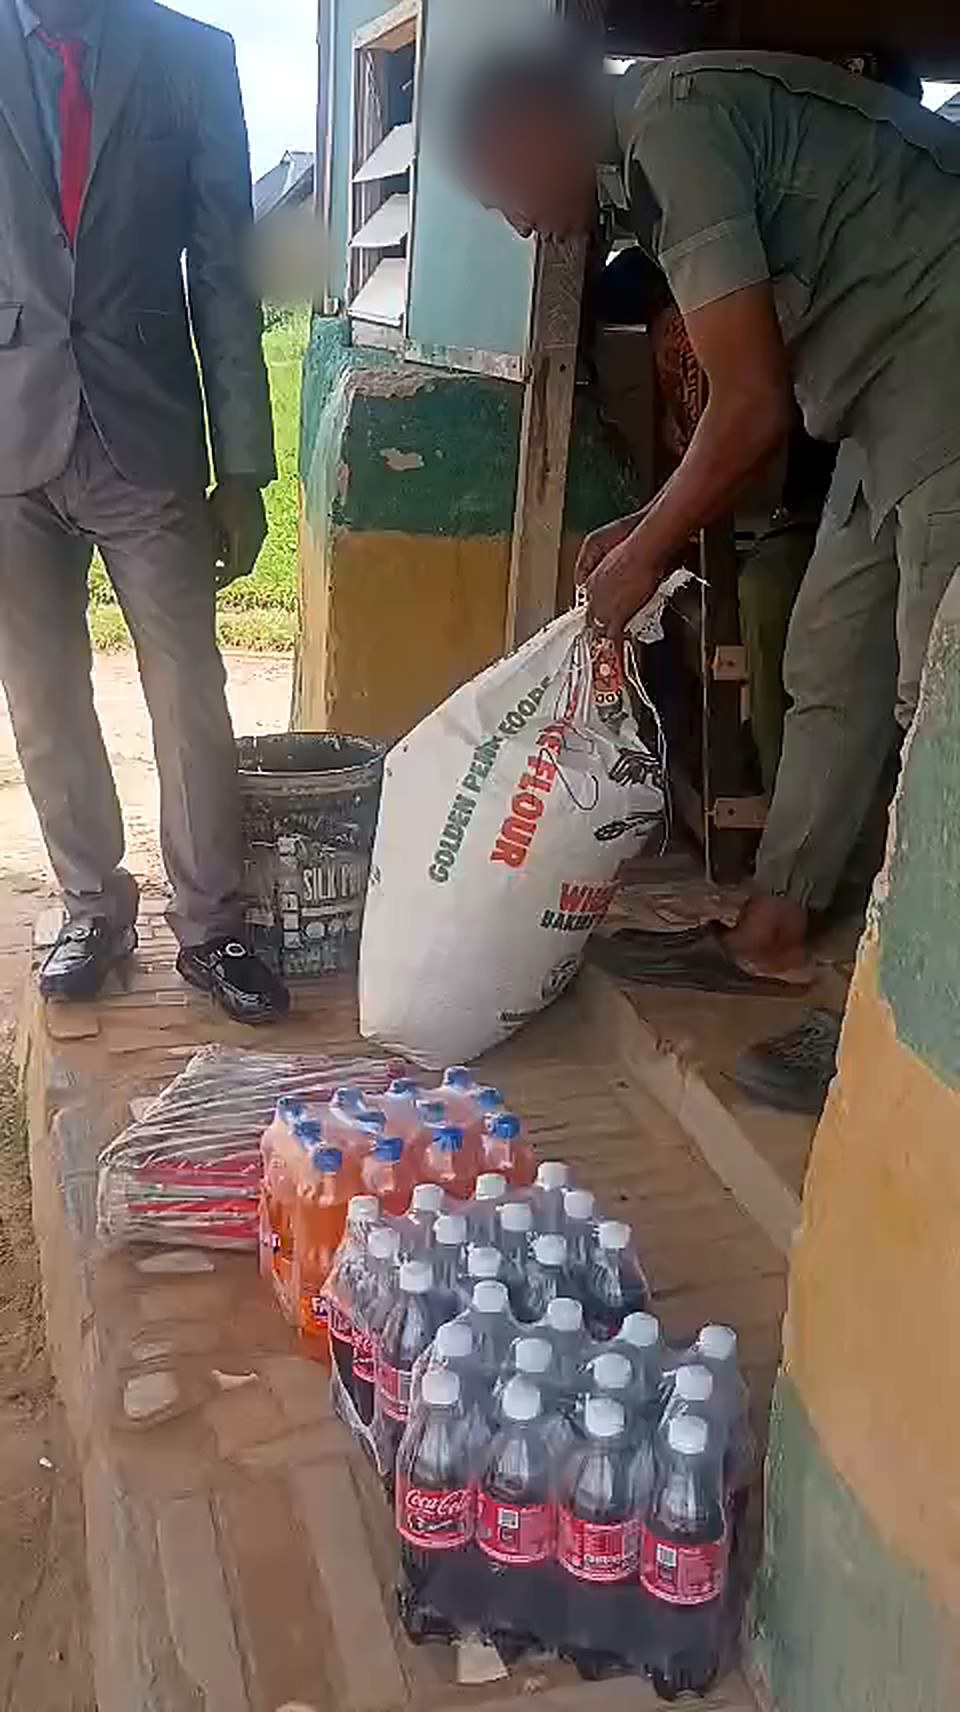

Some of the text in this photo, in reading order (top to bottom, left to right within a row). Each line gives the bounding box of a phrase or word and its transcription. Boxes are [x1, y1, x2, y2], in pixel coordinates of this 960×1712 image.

[429, 793, 476, 883] GOLDEN
[490, 756, 558, 868] FLOUR
[303, 867, 336, 901] SILK
